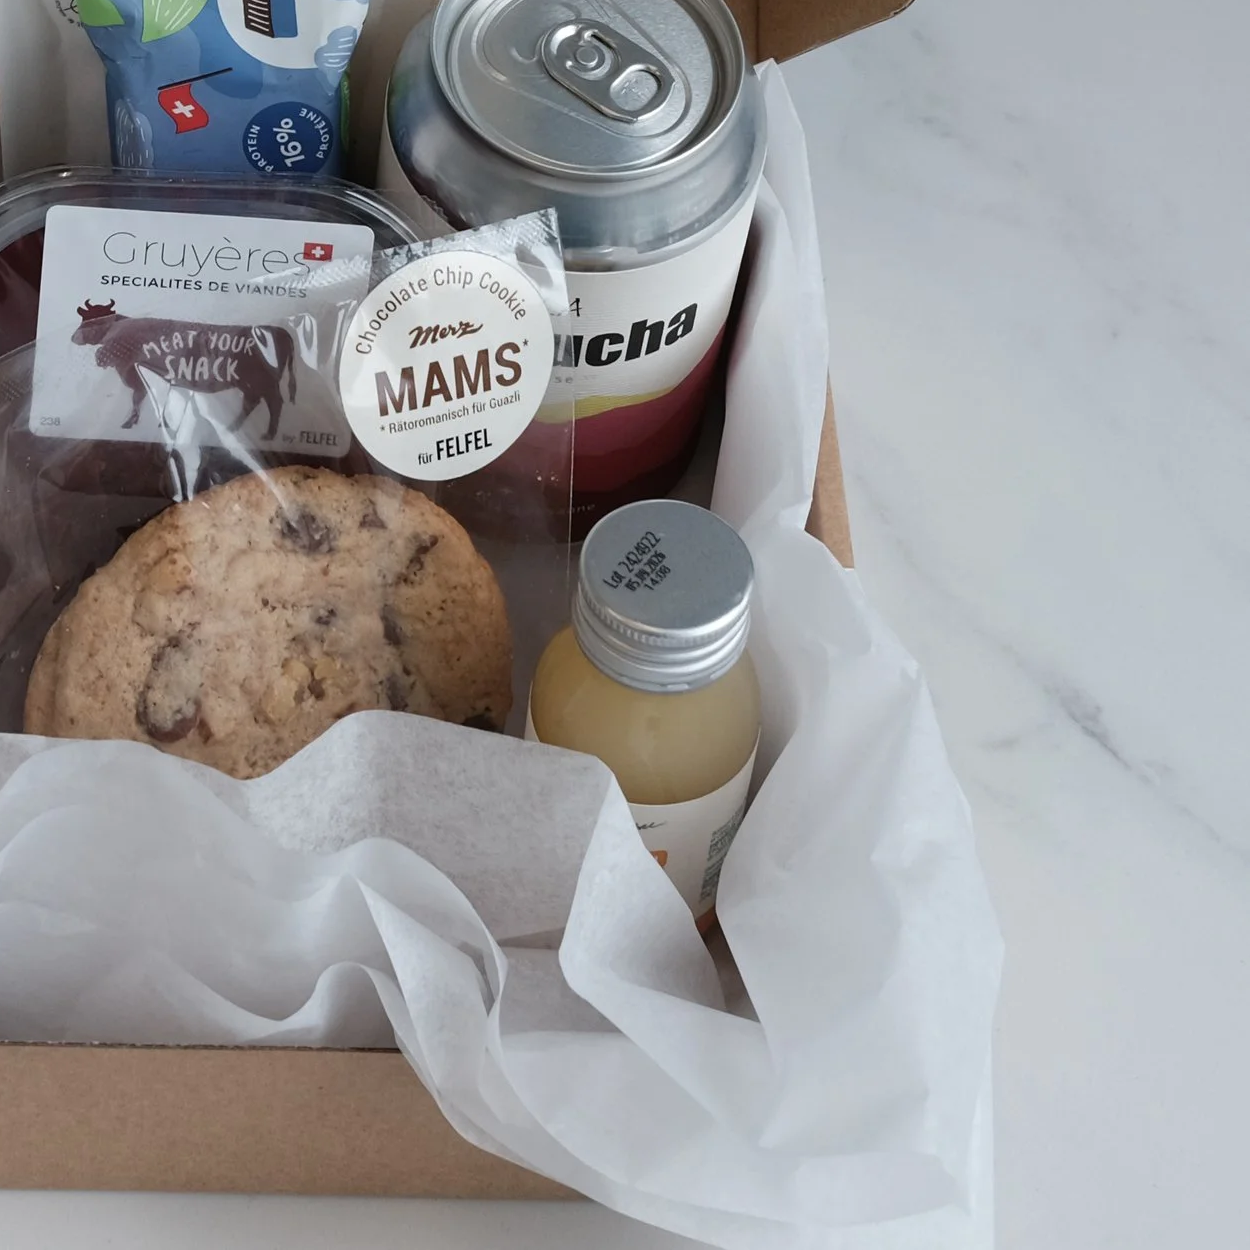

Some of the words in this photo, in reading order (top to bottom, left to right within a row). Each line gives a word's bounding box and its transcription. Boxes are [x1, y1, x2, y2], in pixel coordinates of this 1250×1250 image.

[248, 125, 274, 172] PROTEIN
[273, 118, 305, 167] 16%
[299, 108, 330, 159] PROTÉINE
[103, 232, 311, 277] Gruyères
[101, 275, 202, 291] SPECIALITES
[209, 282, 230, 293] DE
[236, 283, 307, 299] VIANDES
[356, 278, 428, 355] Chocolate
[434, 266, 473, 289] Chip
[478, 272, 527, 321] Cookie
[142, 331, 197, 359] MEAT
[208, 332, 256, 357] YOUR
[409, 321, 484, 349] Merz
[164, 356, 240, 382] SNACK
[389, 405, 469, 434] Rätoromanisch
[472, 401, 486, 415] für
[489, 390, 521, 409] Guazli
[300, 430, 338, 446] FELFEL
[418, 453, 434, 465] für
[436, 428, 492, 461] FELFEL
[603, 570, 626, 589] Lot
